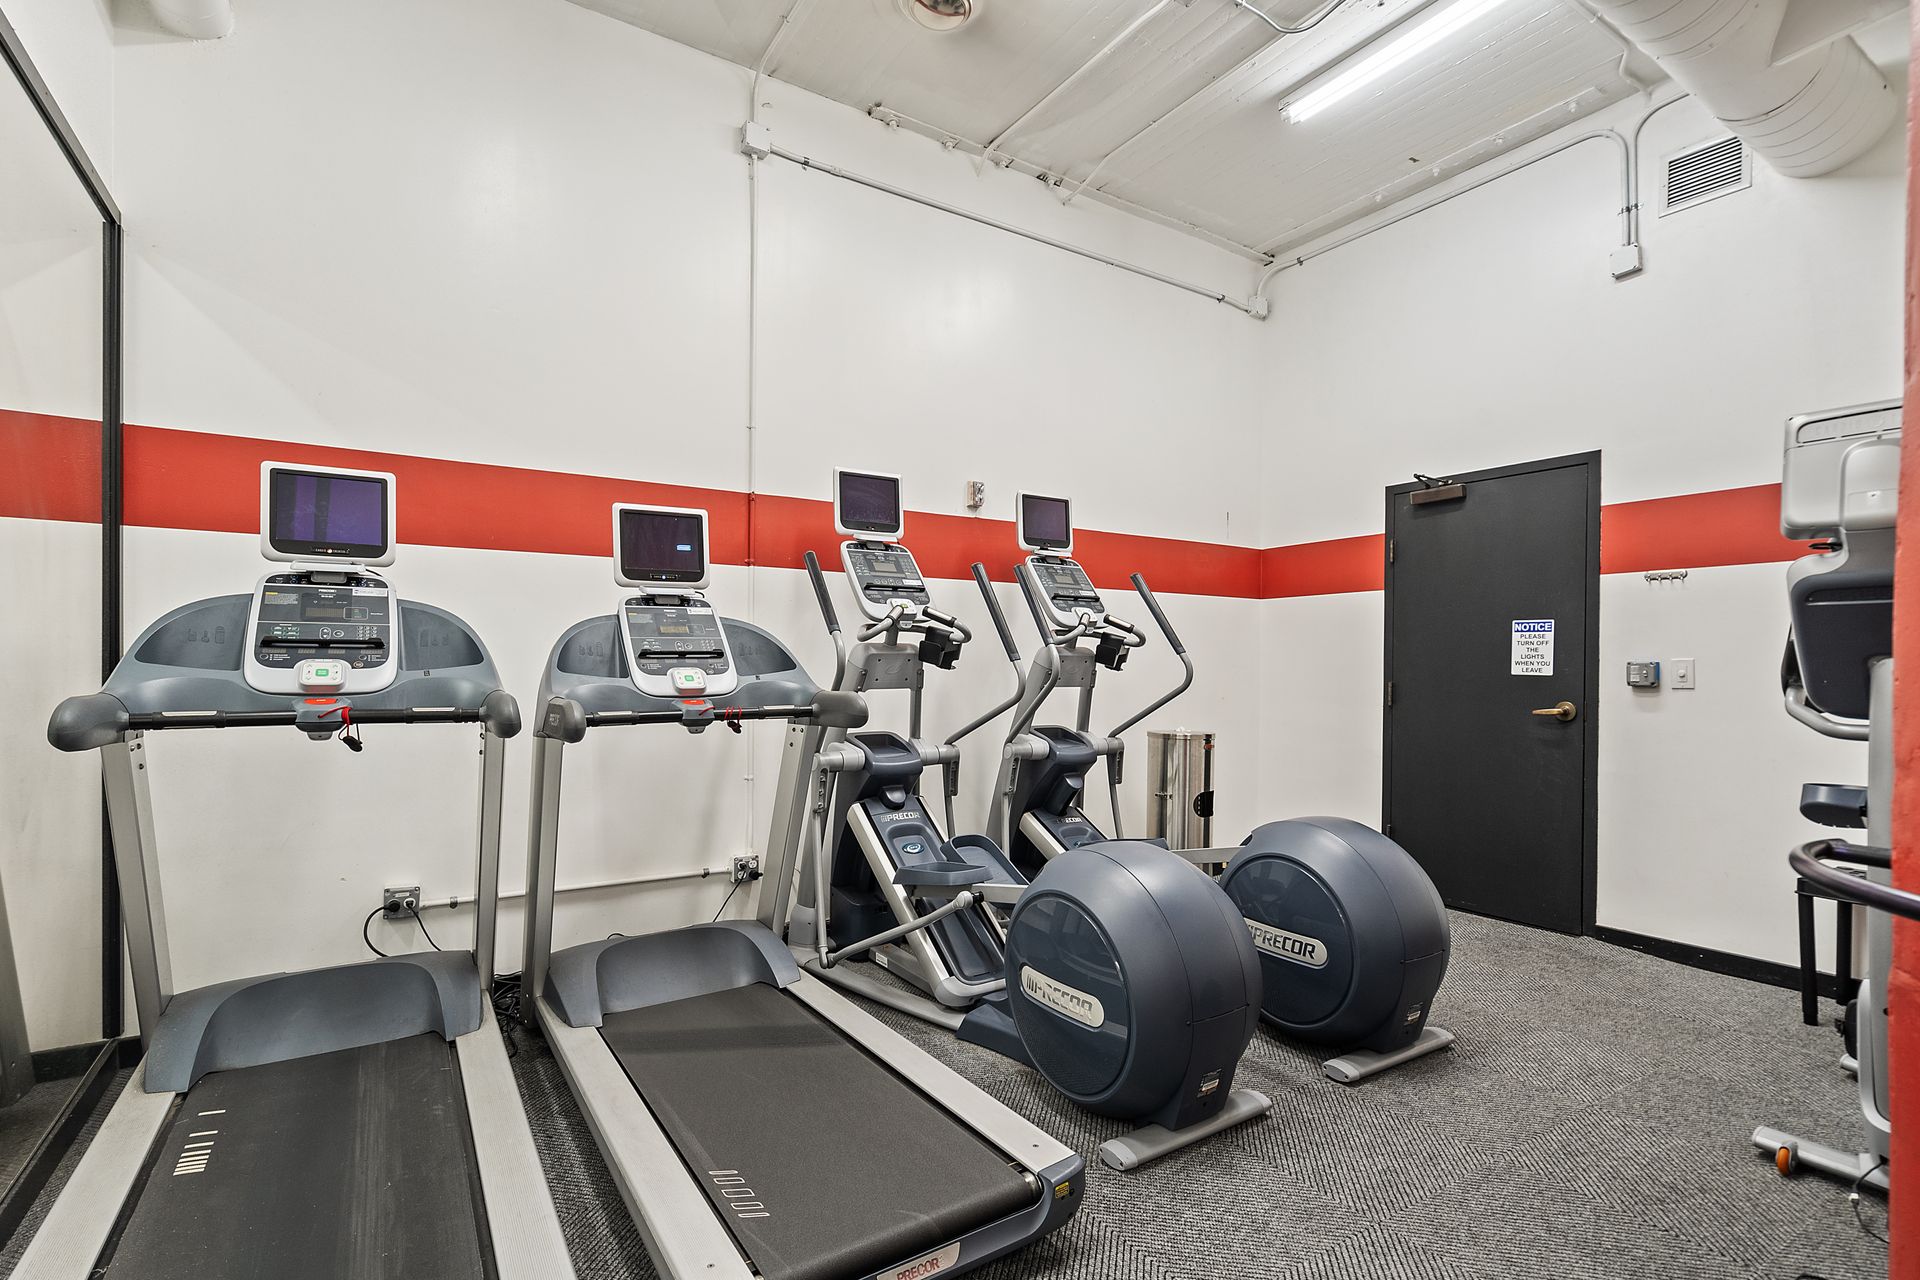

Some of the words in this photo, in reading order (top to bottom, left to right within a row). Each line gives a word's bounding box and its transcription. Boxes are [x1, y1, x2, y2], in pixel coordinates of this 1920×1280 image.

[1515, 623, 1552, 631] NOTICE
[886, 812, 920, 822] PRECOR
[1252, 927, 1316, 960] PRECOR
[896, 1257, 940, 1280] PRECOR
